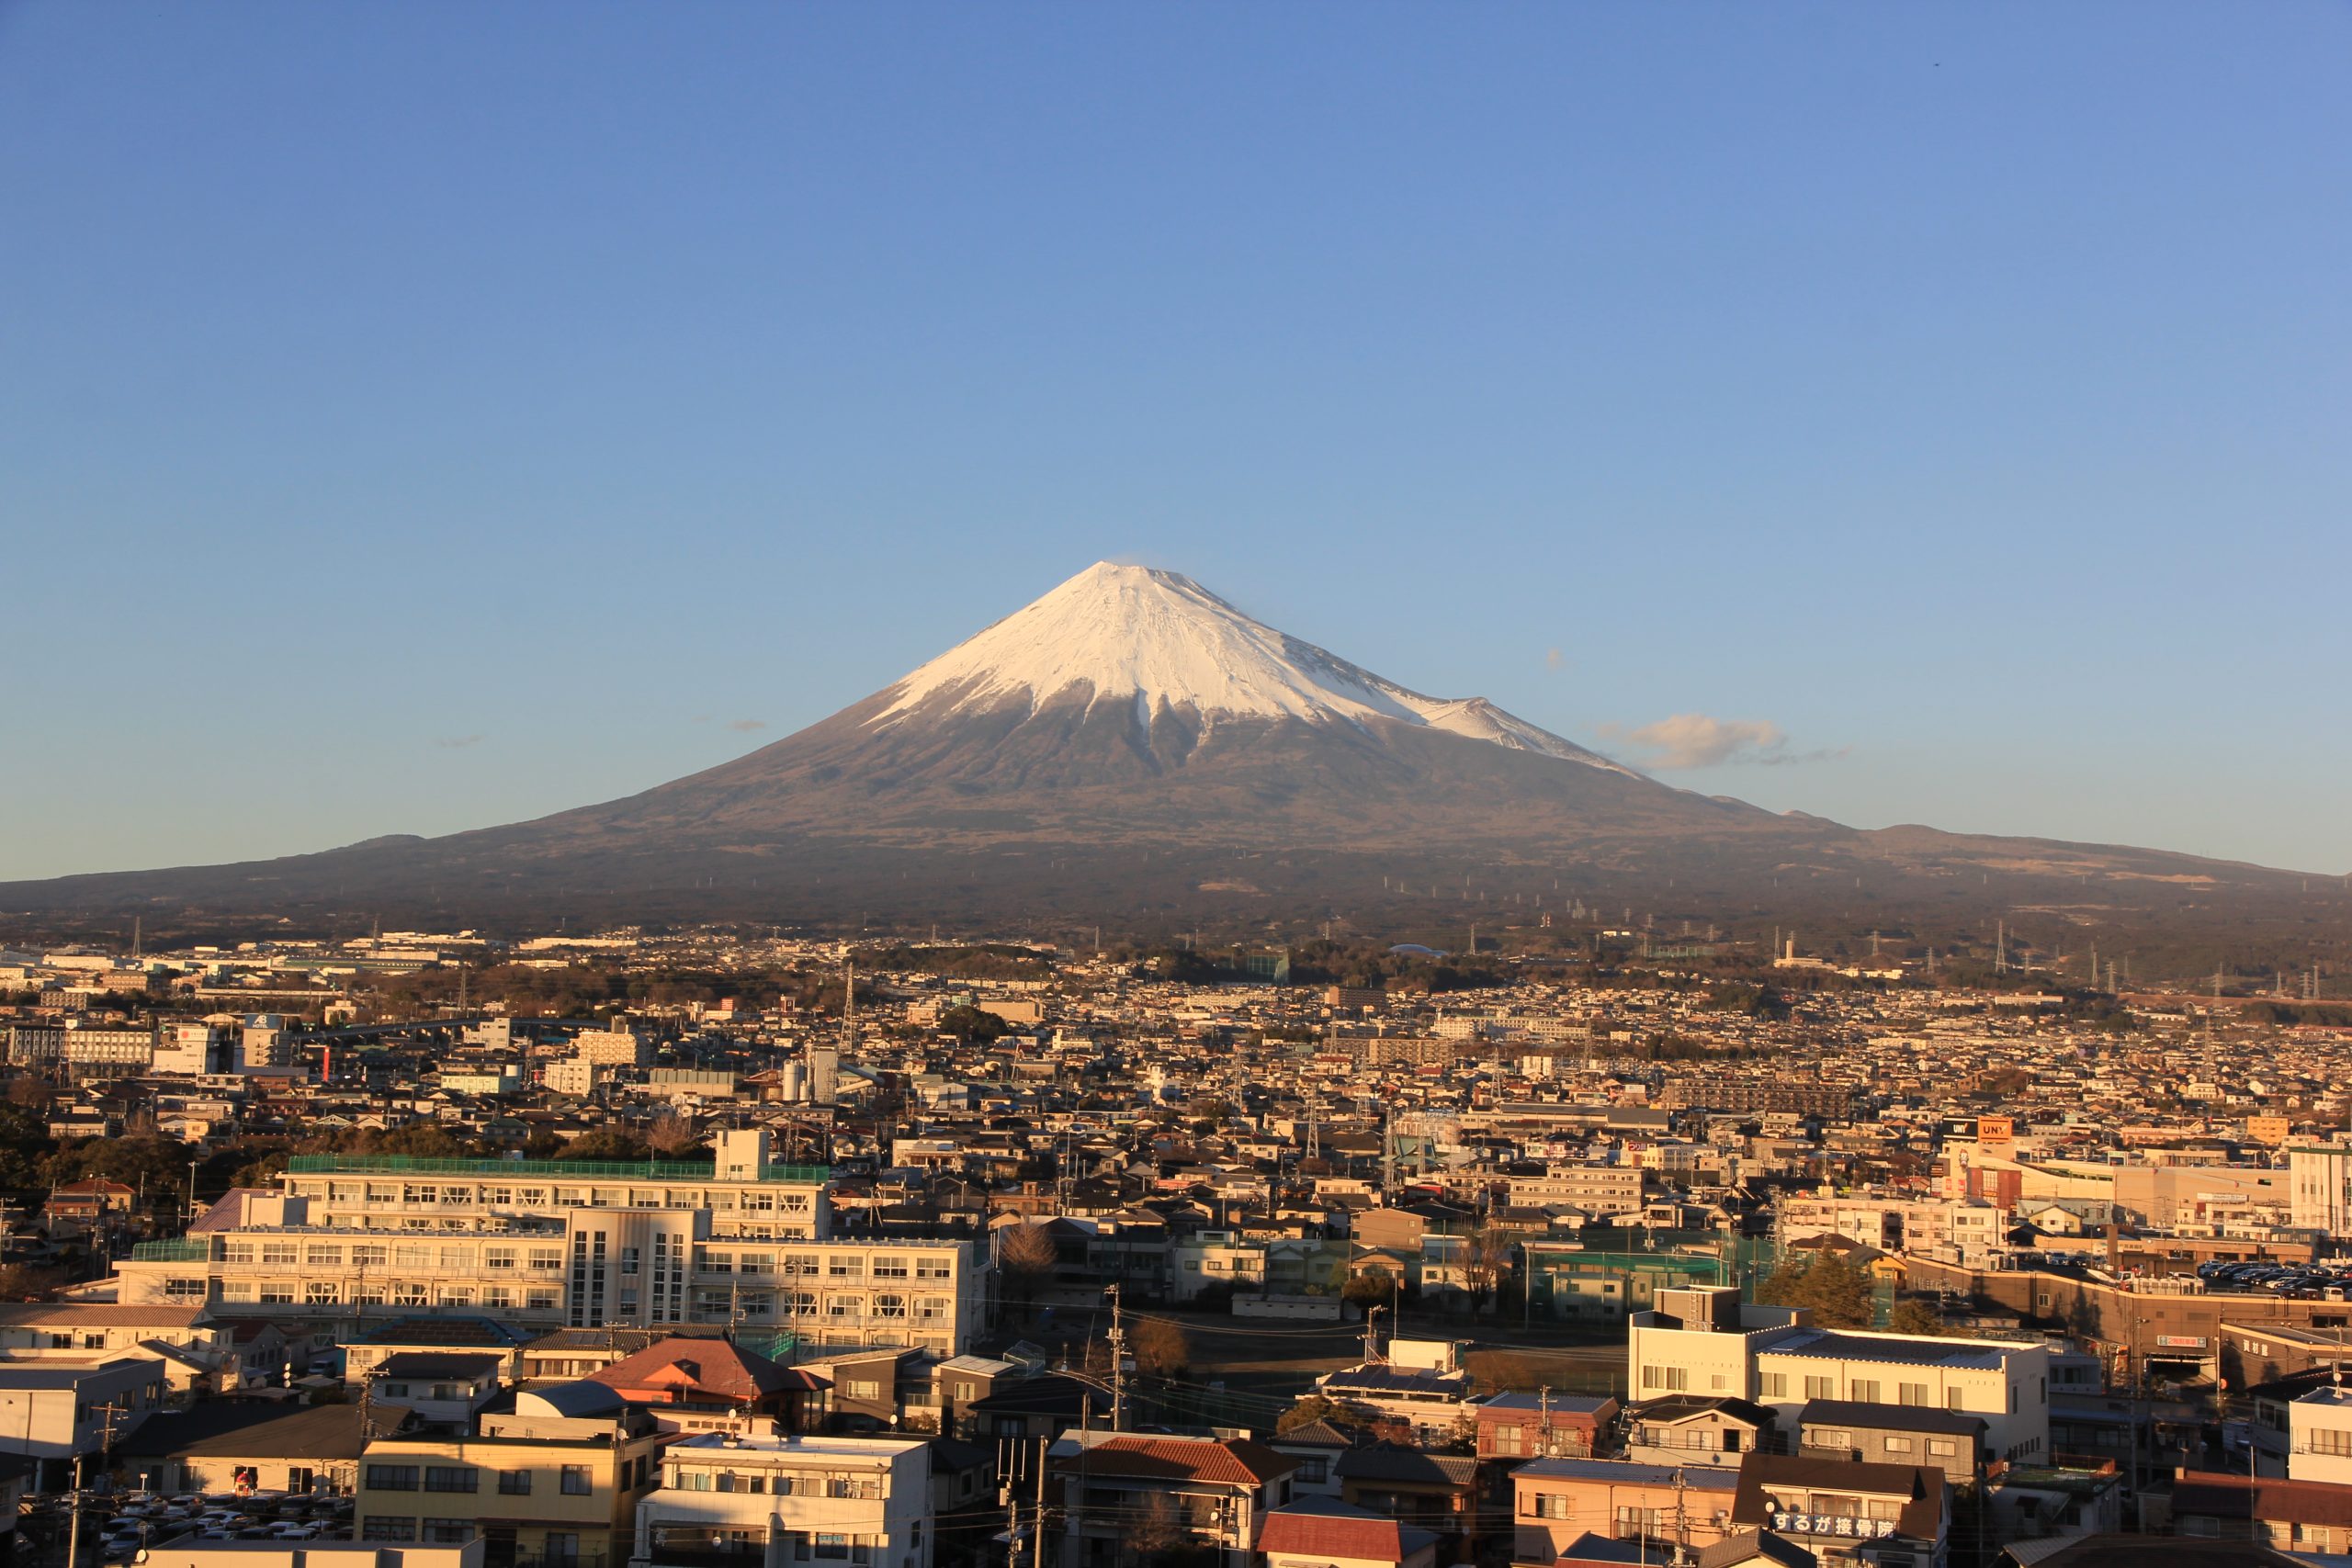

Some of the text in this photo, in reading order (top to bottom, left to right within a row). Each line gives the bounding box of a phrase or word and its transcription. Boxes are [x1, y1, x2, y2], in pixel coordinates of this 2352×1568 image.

[1953, 1122, 1968, 1134] UNY
[1984, 1124, 2007, 1134] UNY
[1773, 1512, 1895, 1539] するが接骨院
